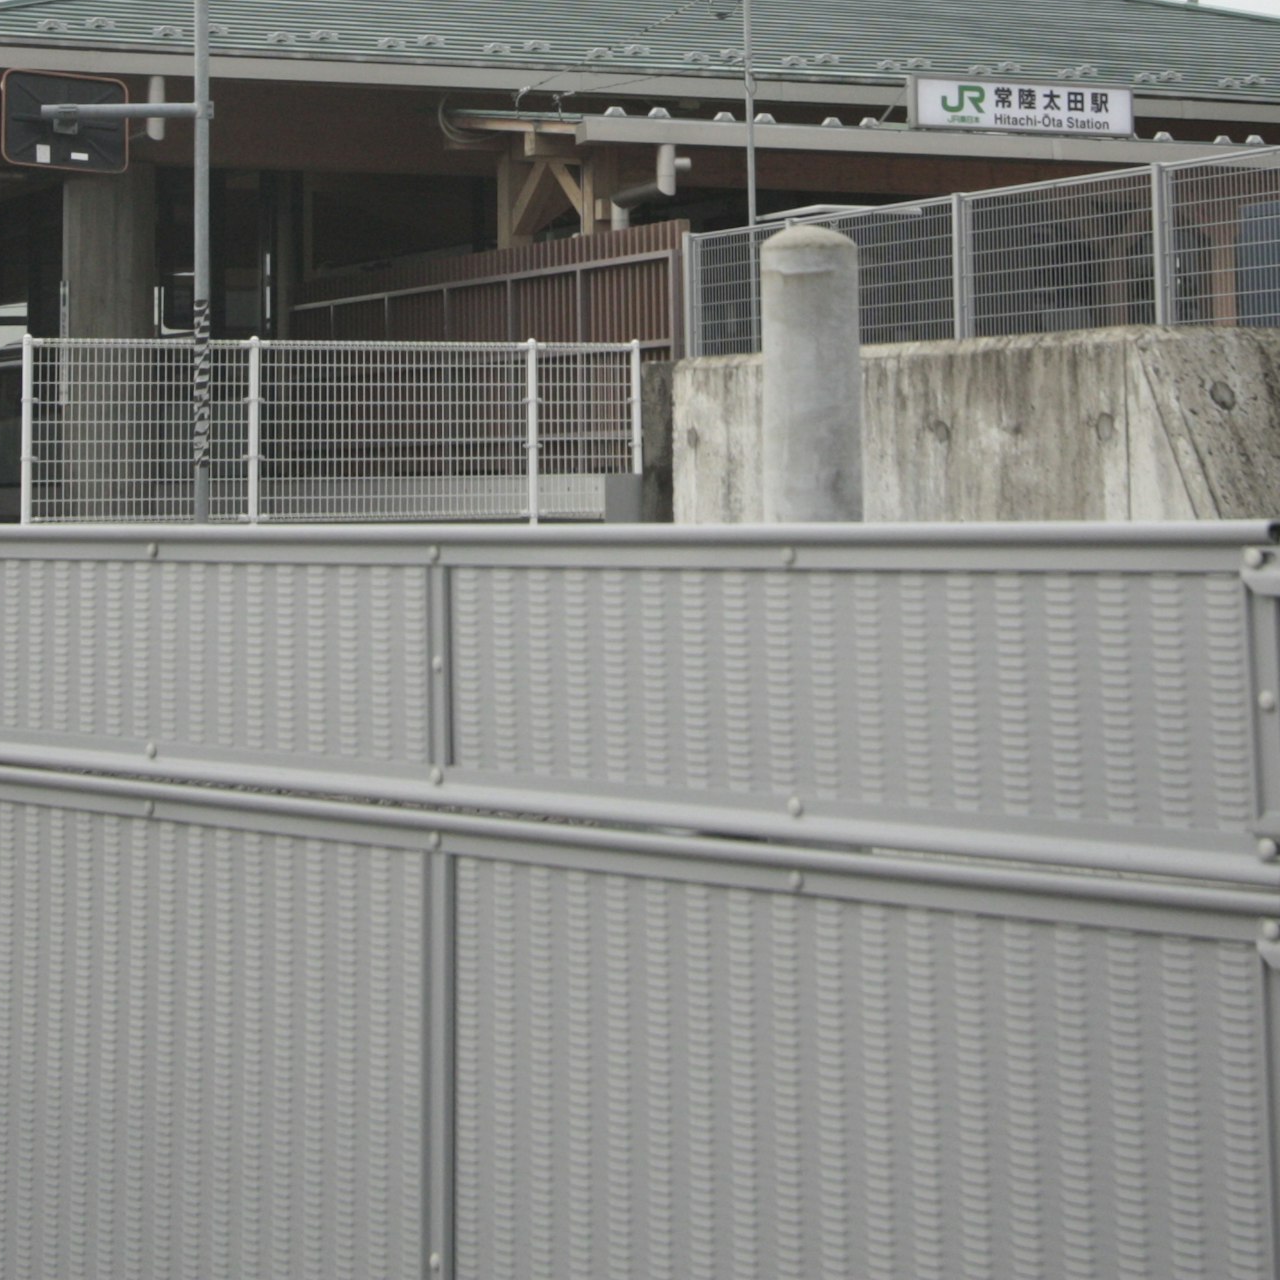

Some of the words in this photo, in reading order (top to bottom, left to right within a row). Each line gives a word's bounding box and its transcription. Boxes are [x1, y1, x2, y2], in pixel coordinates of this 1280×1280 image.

[941, 85, 985, 113] JR
[994, 87, 1109, 113] 常陸太田駅
[1066, 117, 1110, 130] Station
